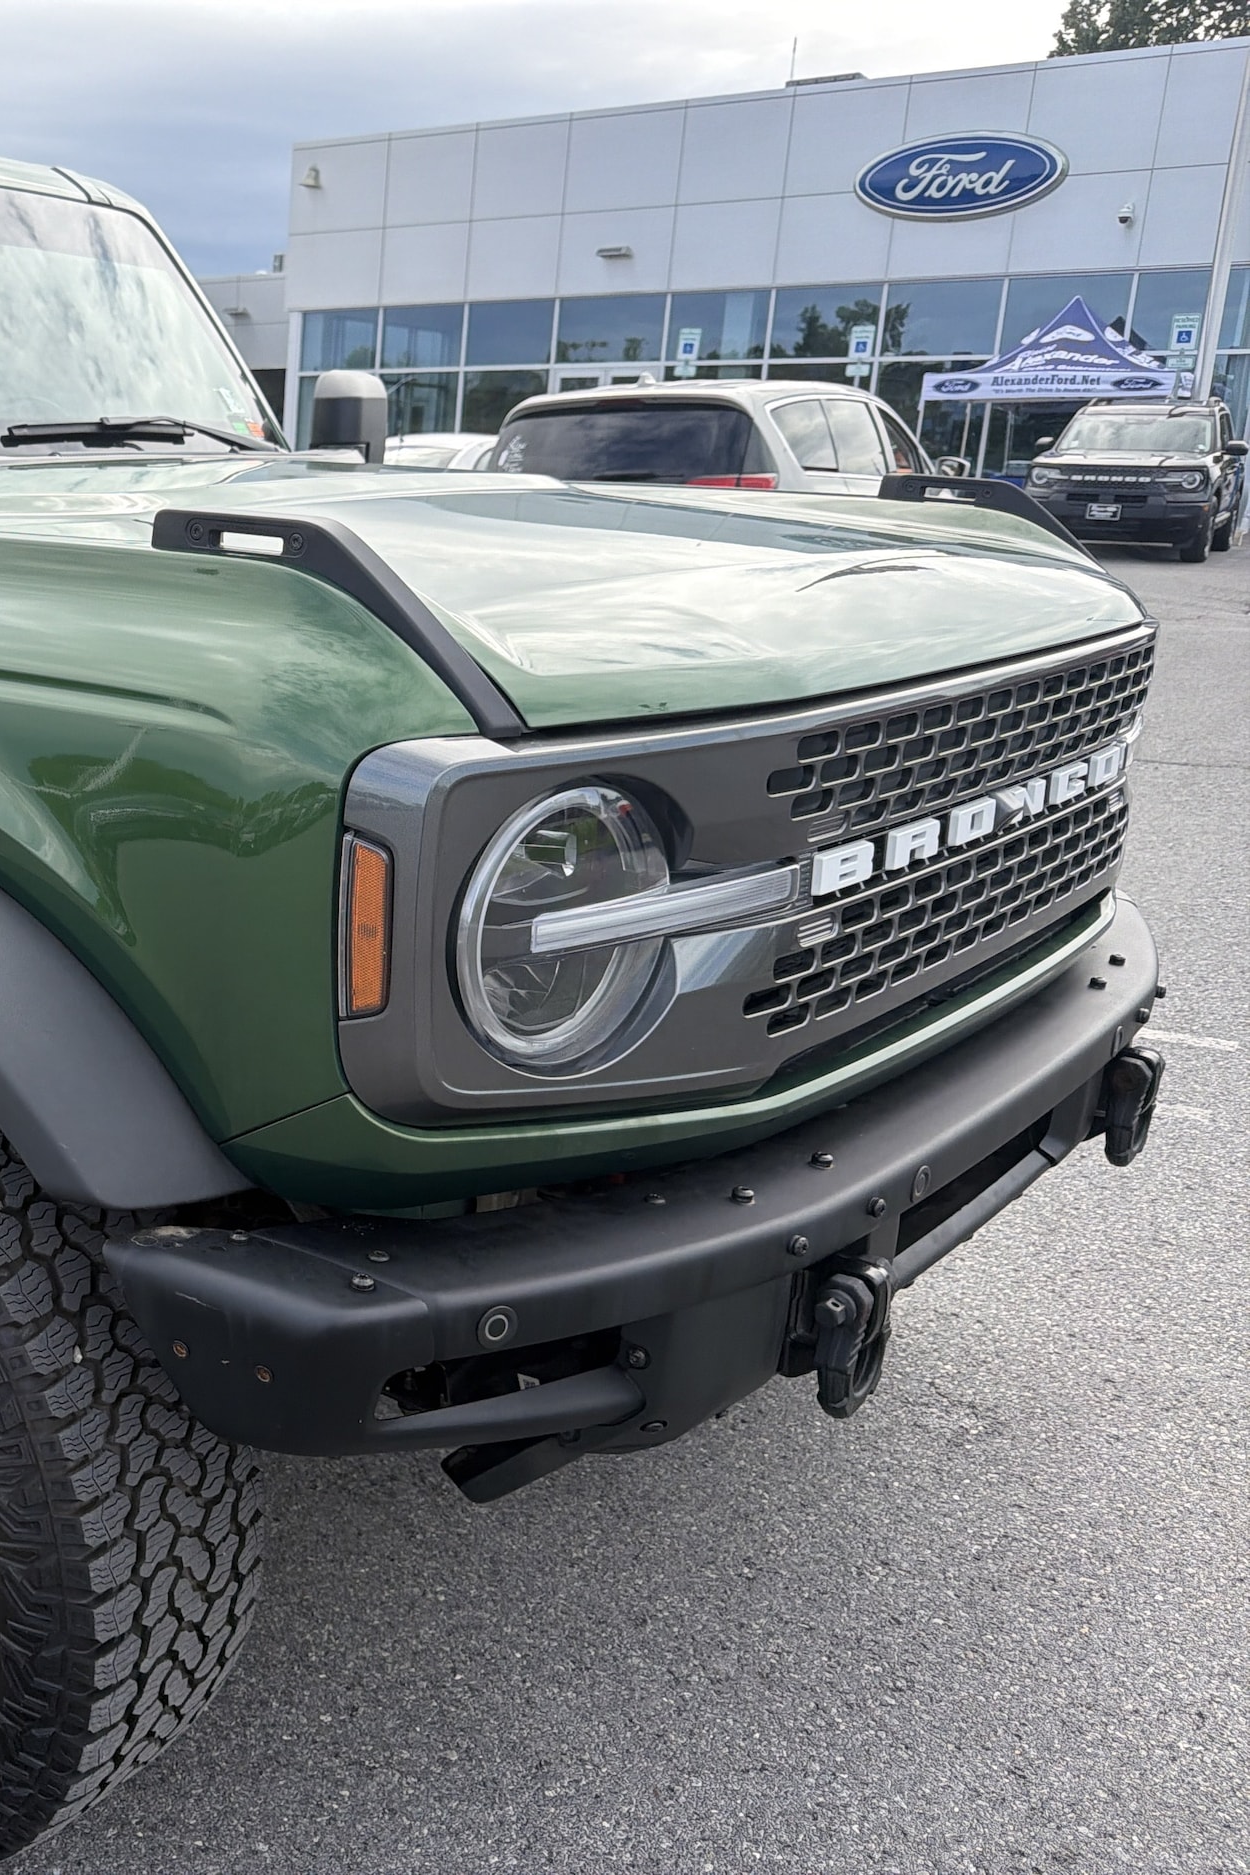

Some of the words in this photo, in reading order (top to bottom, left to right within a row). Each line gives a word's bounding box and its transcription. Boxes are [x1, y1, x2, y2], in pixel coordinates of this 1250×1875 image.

[895, 151, 1016, 201] Ford
[941, 381, 971, 392] Ford
[991, 374, 1101, 387] AlexanderFord.Net
[1120, 379, 1154, 389] Ford
[1070, 475, 1152, 483] BRONCO
[811, 744, 1124, 896] BRONCO
